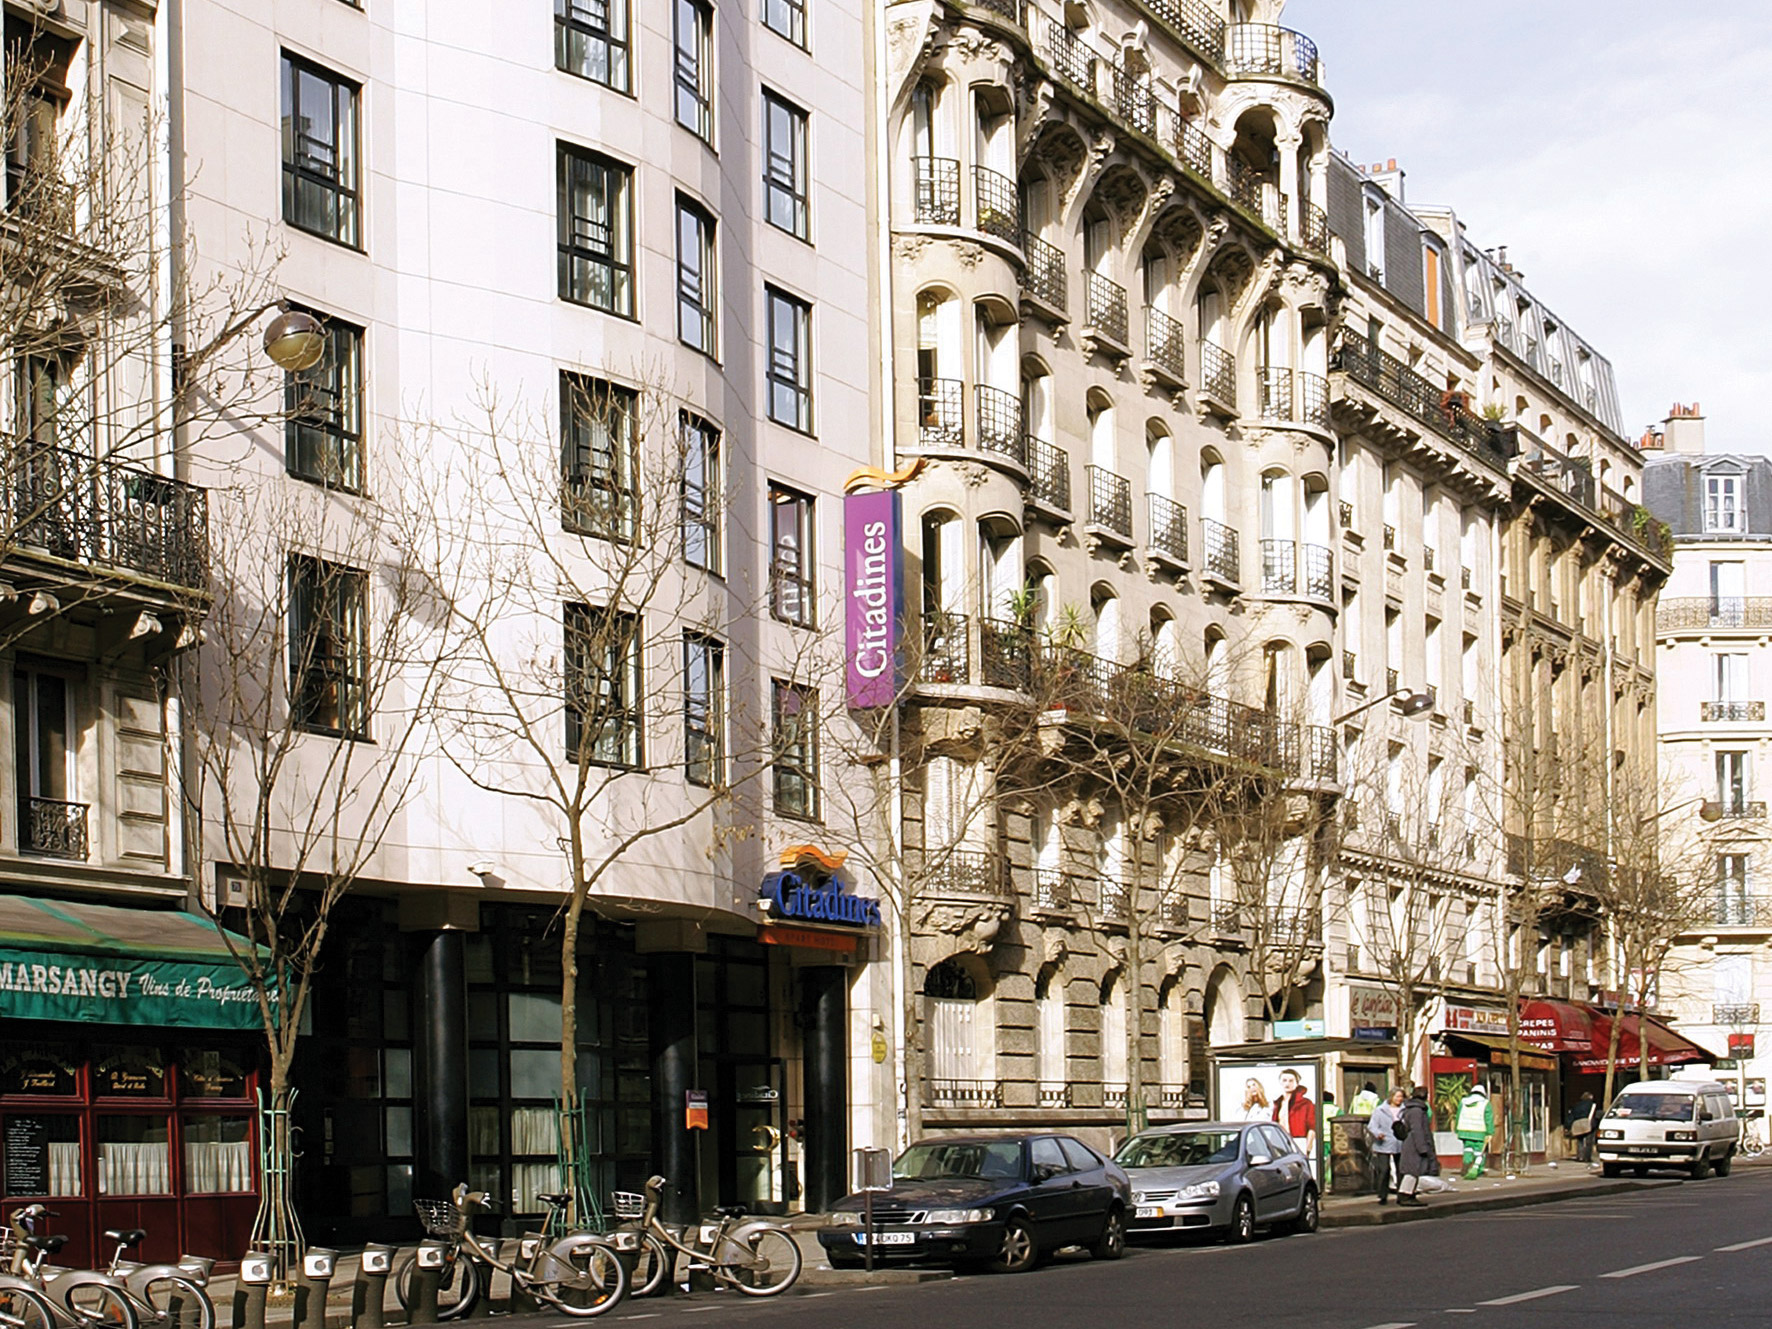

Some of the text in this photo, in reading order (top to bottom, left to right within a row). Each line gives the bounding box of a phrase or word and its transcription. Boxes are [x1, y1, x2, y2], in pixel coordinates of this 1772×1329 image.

[853, 521, 887, 678] Citadines
[776, 871, 881, 926] Citadines
[139, 972, 169, 997] Vins
[175, 978, 191, 998] de
